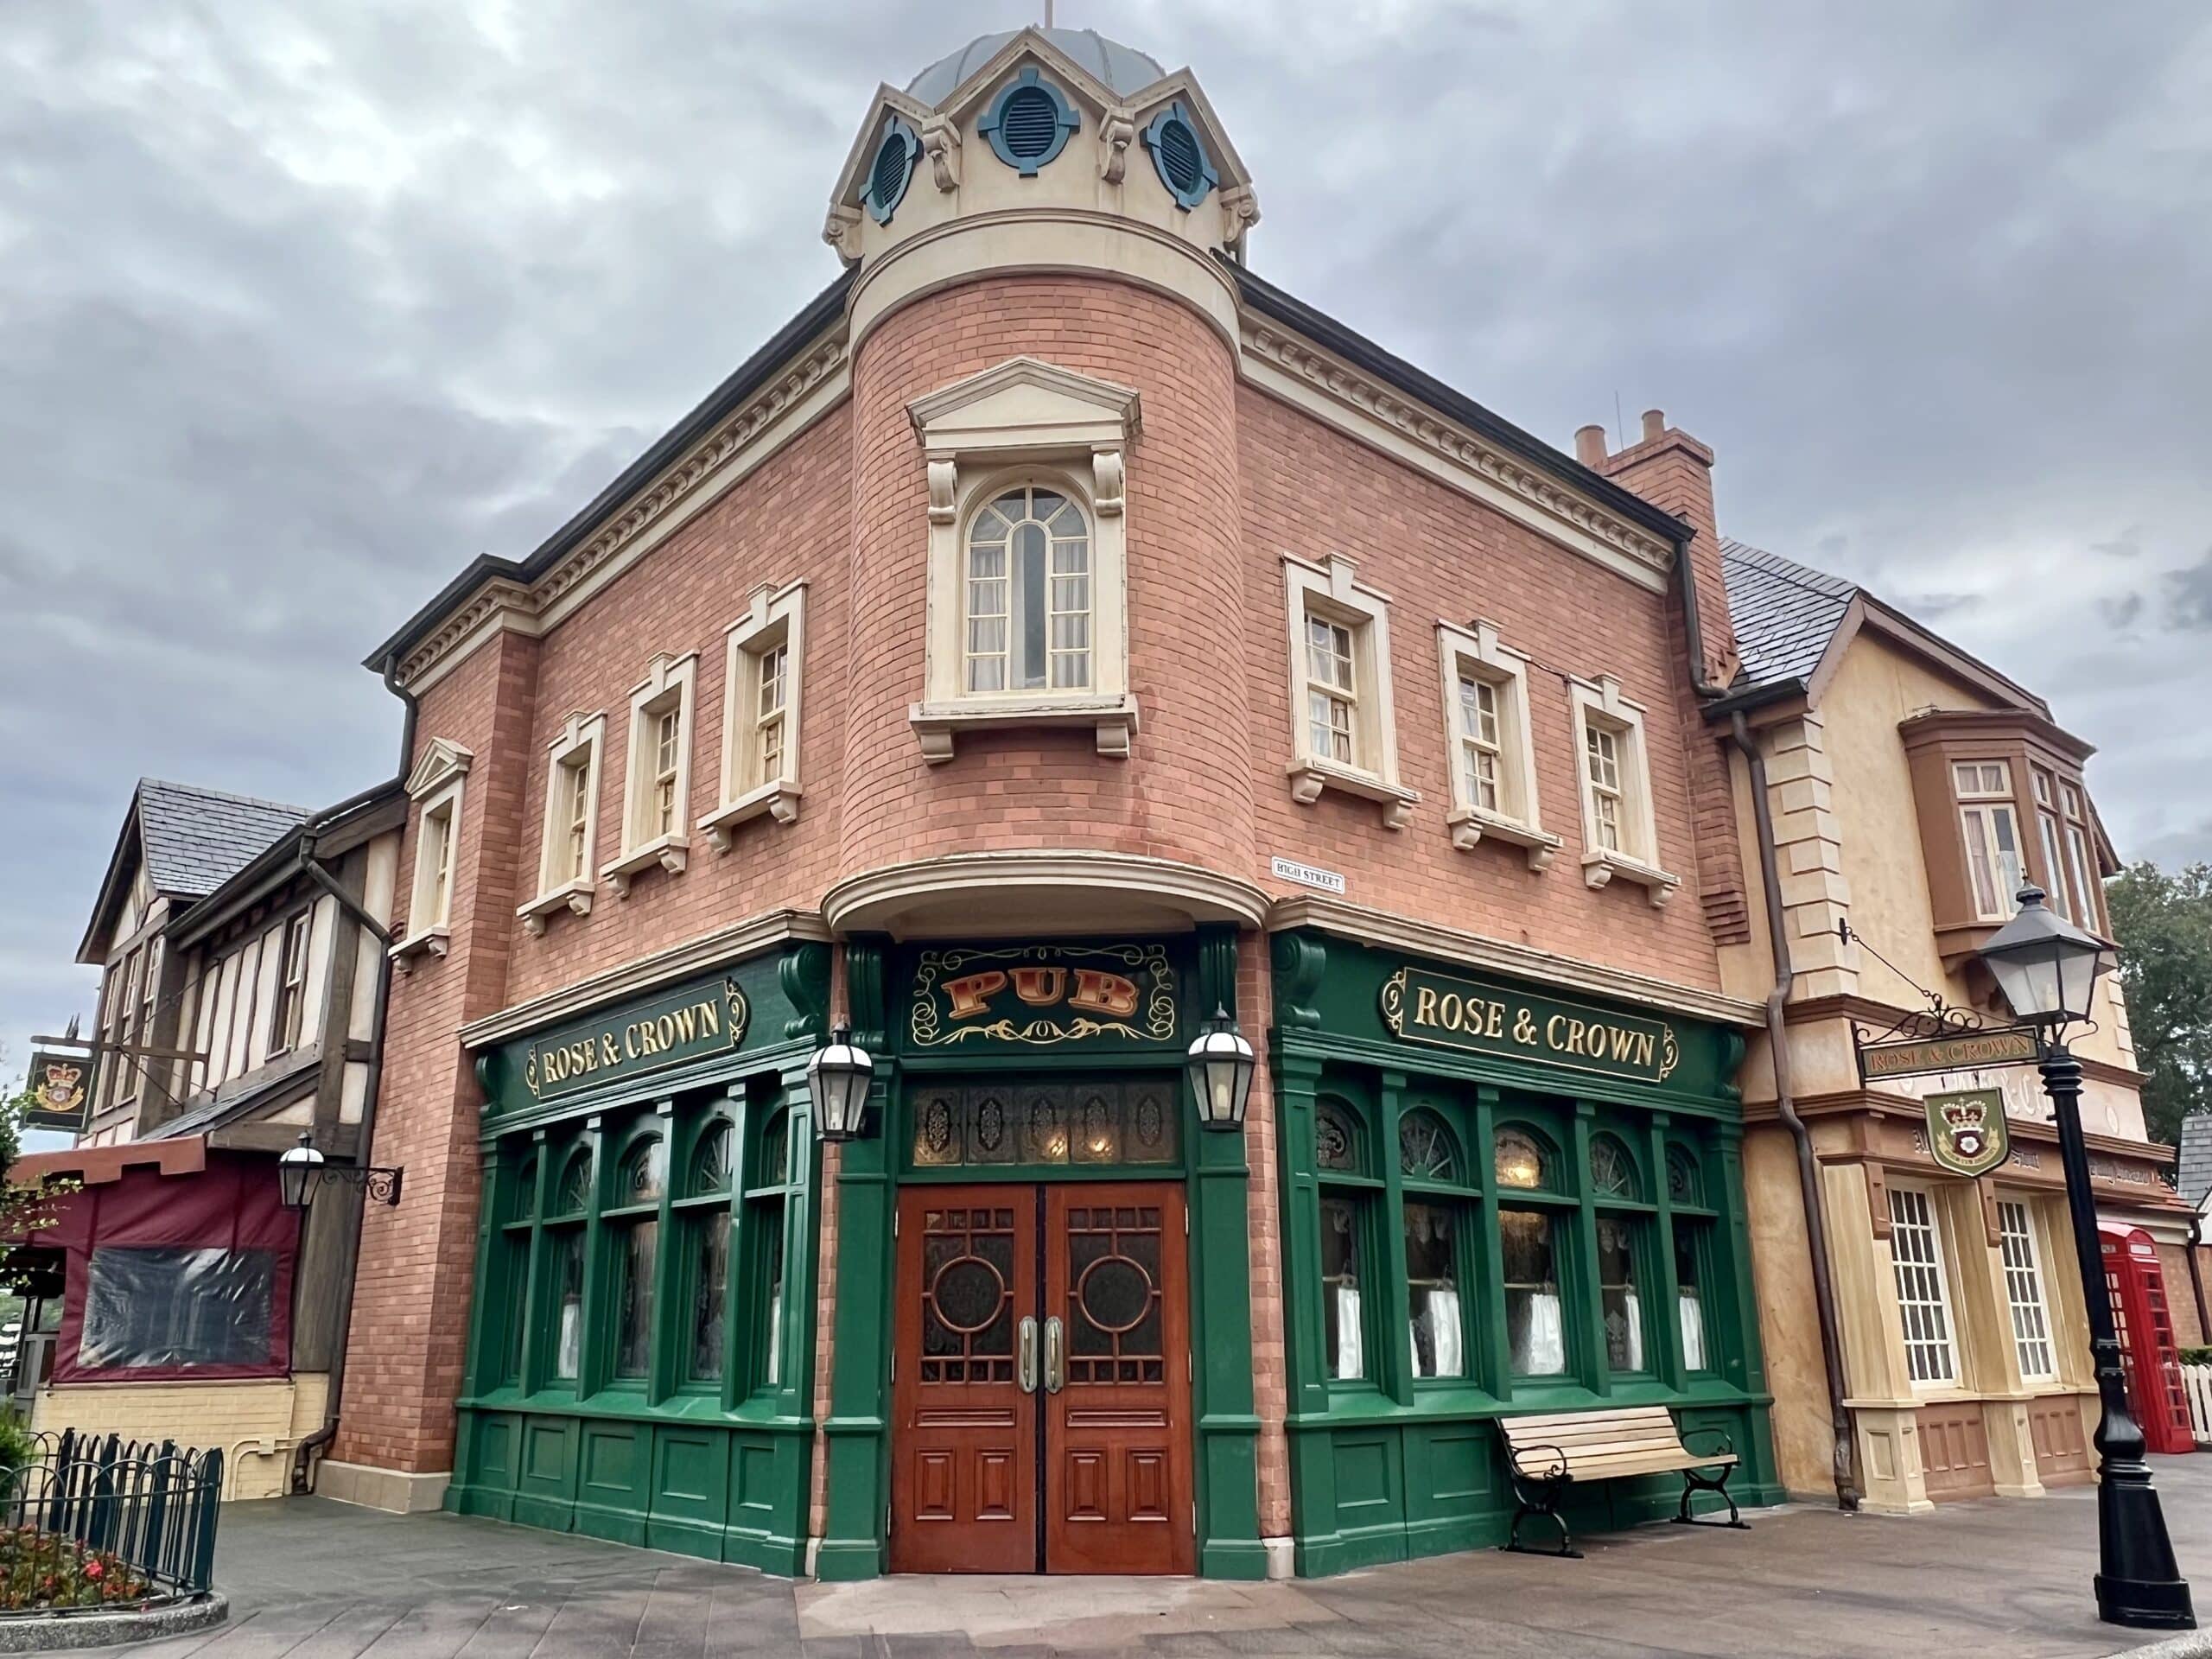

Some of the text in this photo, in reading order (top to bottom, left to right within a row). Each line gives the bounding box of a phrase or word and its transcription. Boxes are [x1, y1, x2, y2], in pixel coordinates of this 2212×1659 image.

[1276, 862, 1340, 888] HIGH STREET
[940, 966, 1140, 1020] PUB
[542, 999, 720, 1084] ROSE & CROWN
[1413, 986, 1656, 1067] ROSE & CROWN
[1870, 1036, 2030, 1072] ROSE & CROWN
